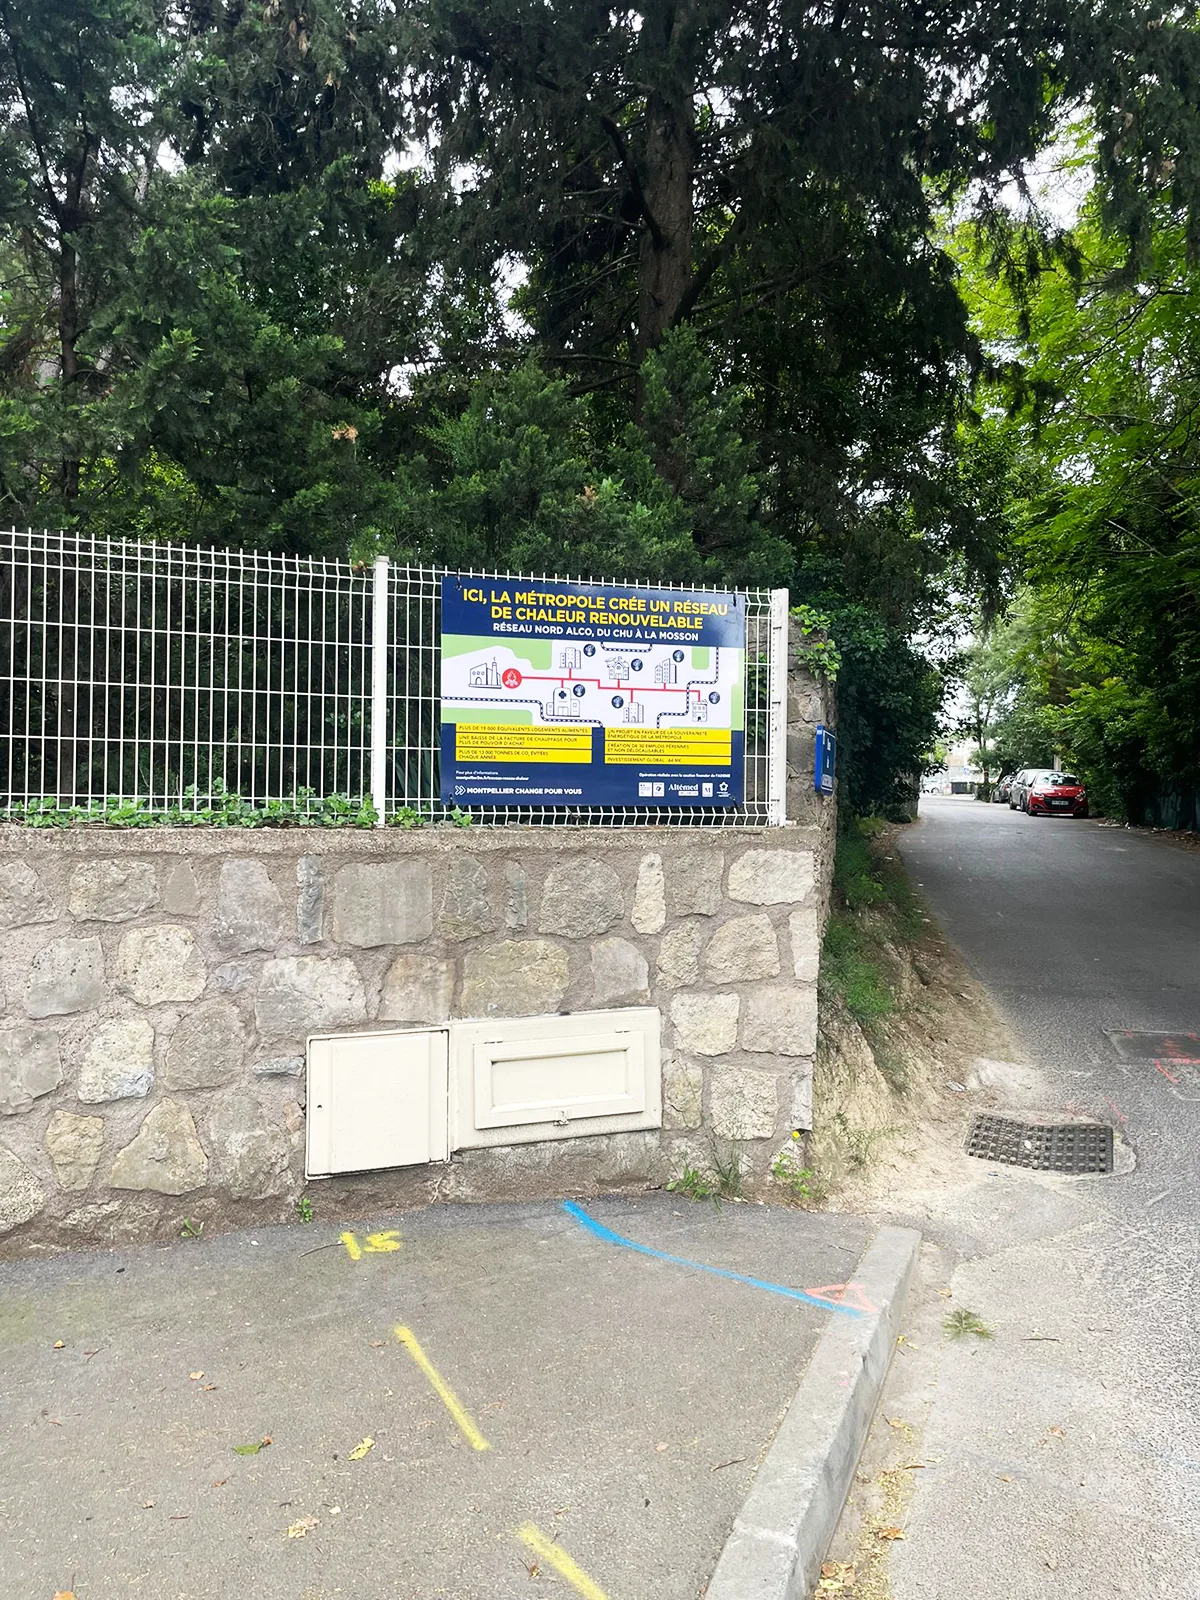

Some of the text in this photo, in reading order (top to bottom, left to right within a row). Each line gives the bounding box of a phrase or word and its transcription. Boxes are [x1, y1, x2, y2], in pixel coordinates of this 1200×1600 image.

[463, 588, 728, 616] ICI, LA MÉTROPOLE CRÉE UN RÉSEAU
[491, 606, 704, 630] DE CHALEUR RENOUVELABLE
[493, 622, 698, 641] RÉSEAU NORD ALCO, DU CHU À LA MOSSON
